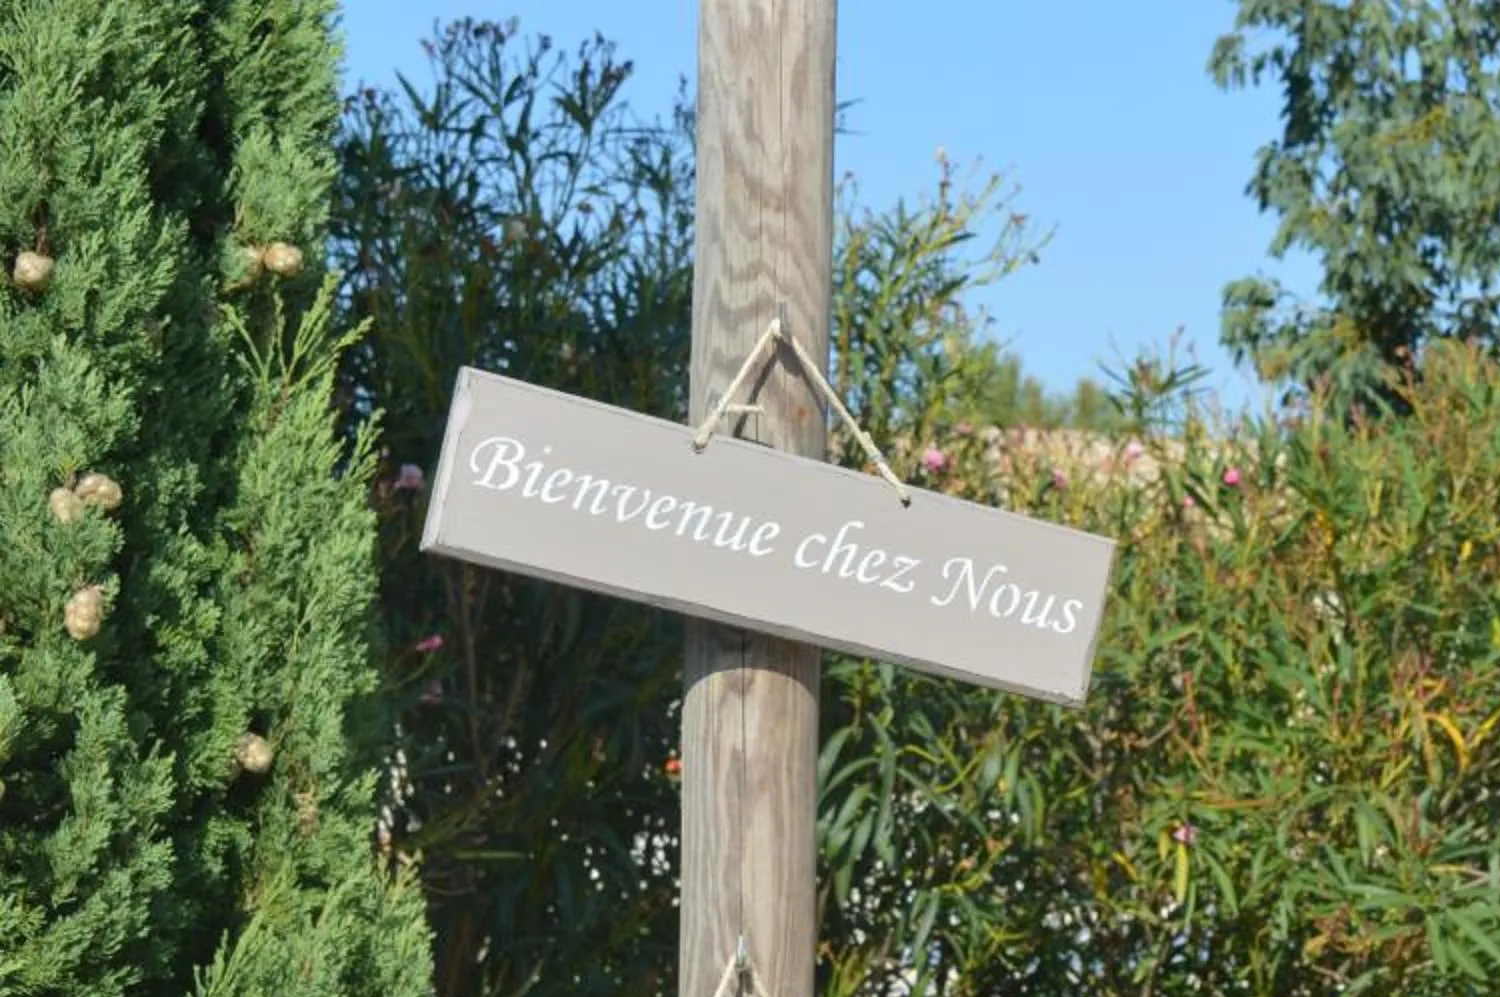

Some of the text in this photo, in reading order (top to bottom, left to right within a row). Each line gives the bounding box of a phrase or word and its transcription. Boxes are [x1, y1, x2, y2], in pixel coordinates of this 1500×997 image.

[469, 435, 1084, 635] Bienvenue chez Nous
